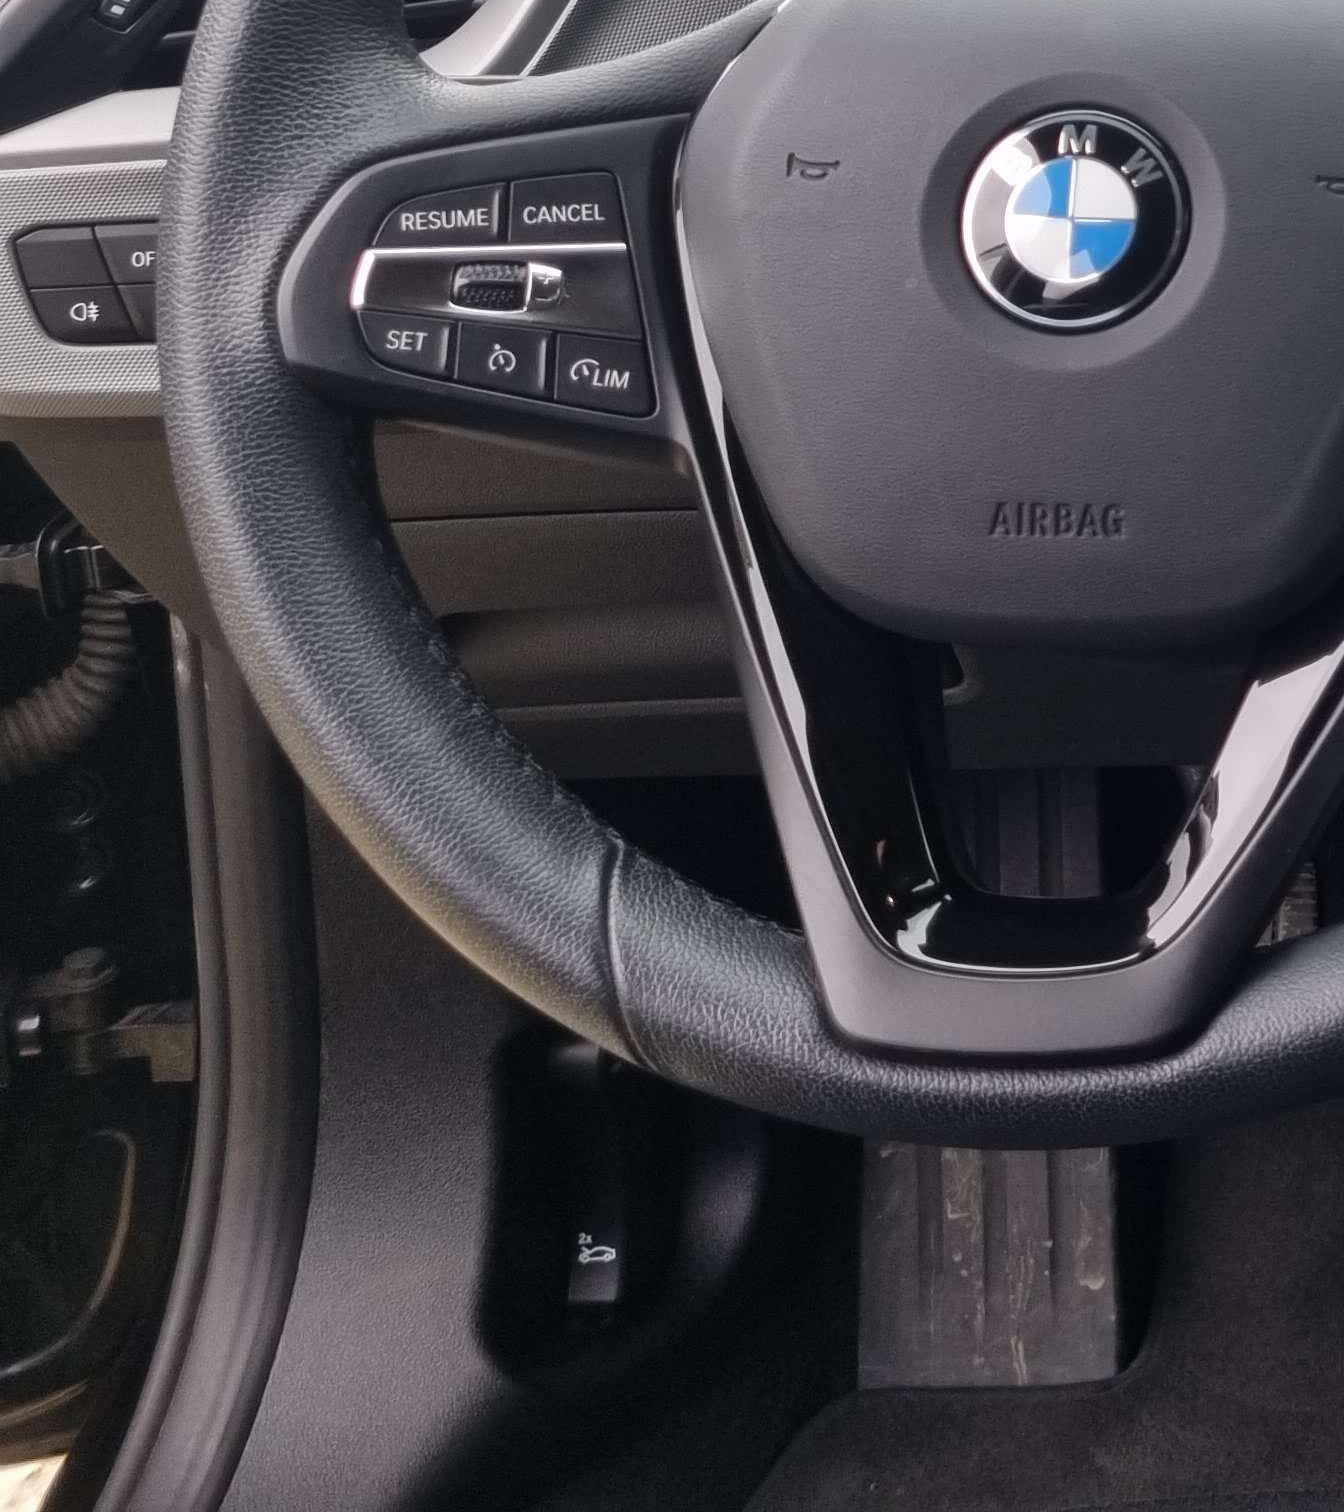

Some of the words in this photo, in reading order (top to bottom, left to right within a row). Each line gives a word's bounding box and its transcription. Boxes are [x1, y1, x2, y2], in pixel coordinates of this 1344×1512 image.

[990, 123, 1165, 188] BMW
[400, 208, 490, 232] RESUME
[522, 203, 605, 225] CANCEL
[385, 329, 428, 352] SET
[591, 368, 630, 389] LIM
[987, 501, 1127, 538] AIRBAG
